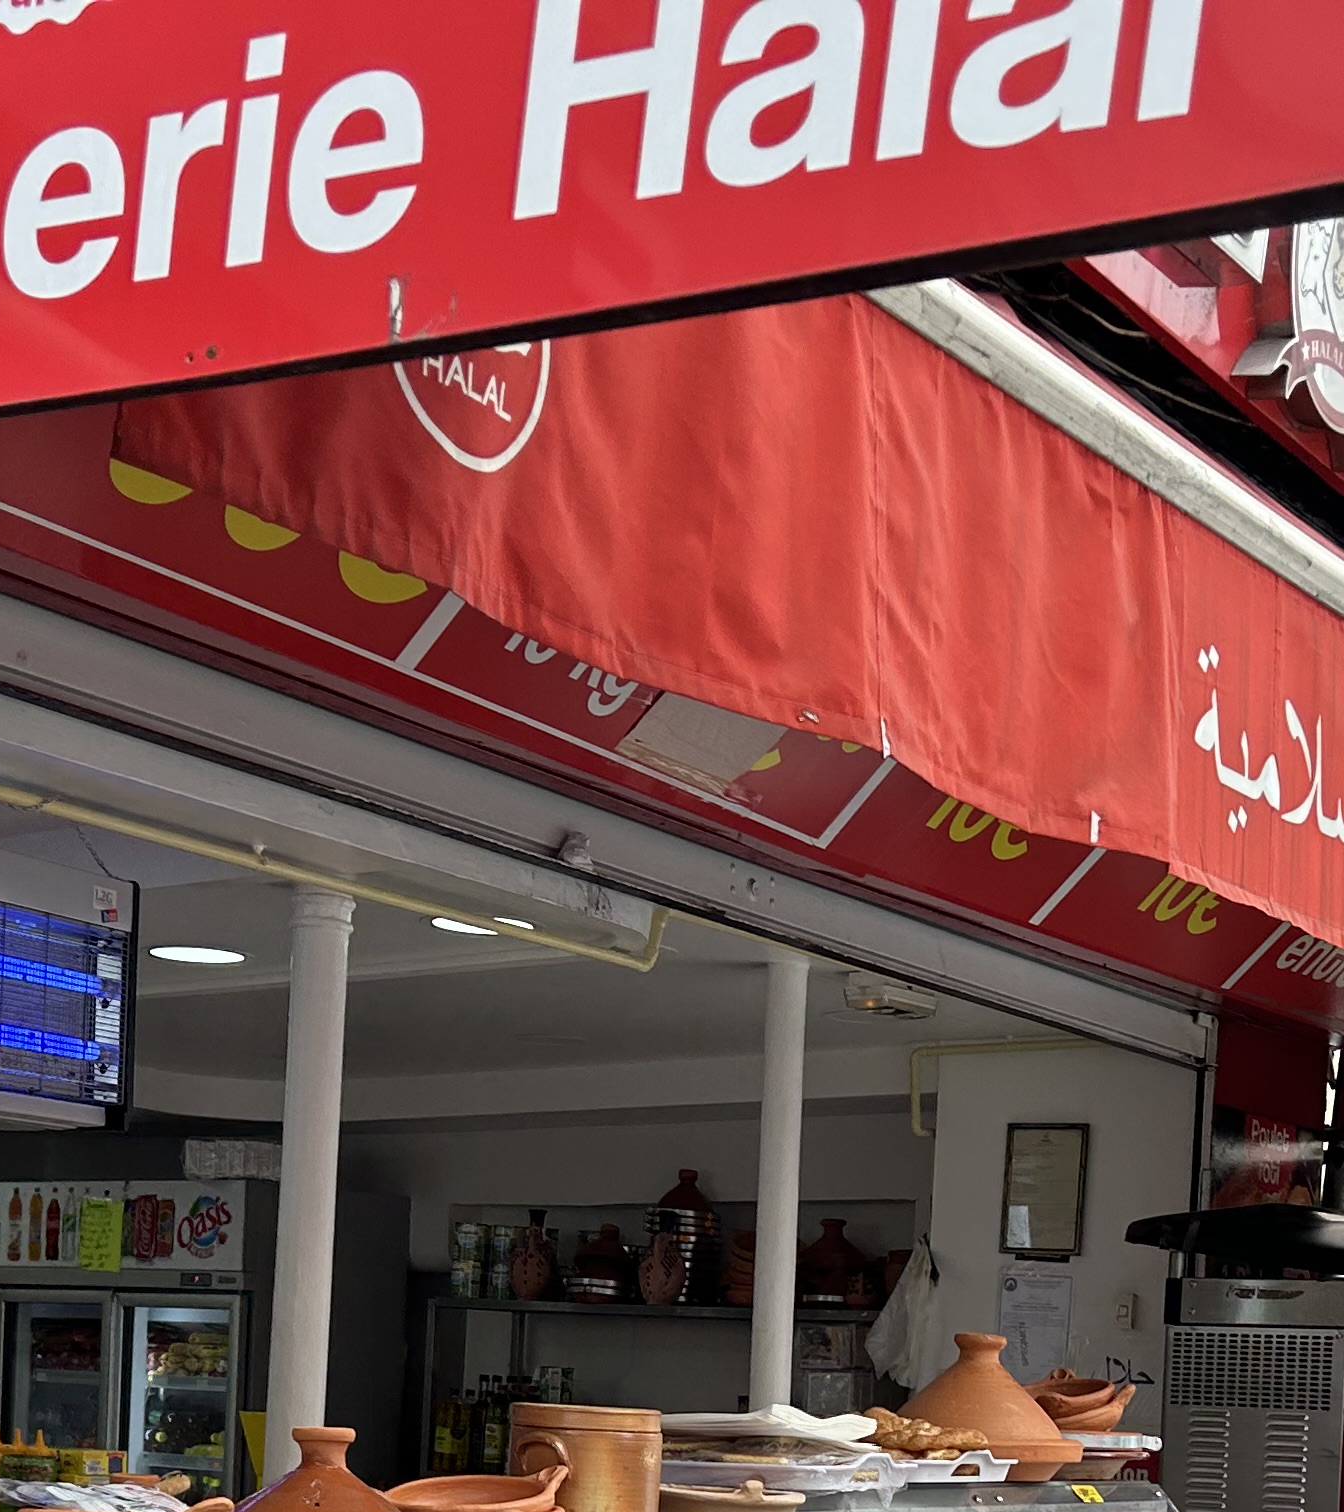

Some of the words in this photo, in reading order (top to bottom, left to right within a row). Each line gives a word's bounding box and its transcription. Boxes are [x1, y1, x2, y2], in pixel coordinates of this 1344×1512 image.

[512, 0, 1192, 220] Halal
[1311, 340, 1344, 371] HALAL
[422, 355, 512, 423] HALAL
[1251, 1118, 1290, 1153] Poulet
[177, 1196, 233, 1249] Oasis
